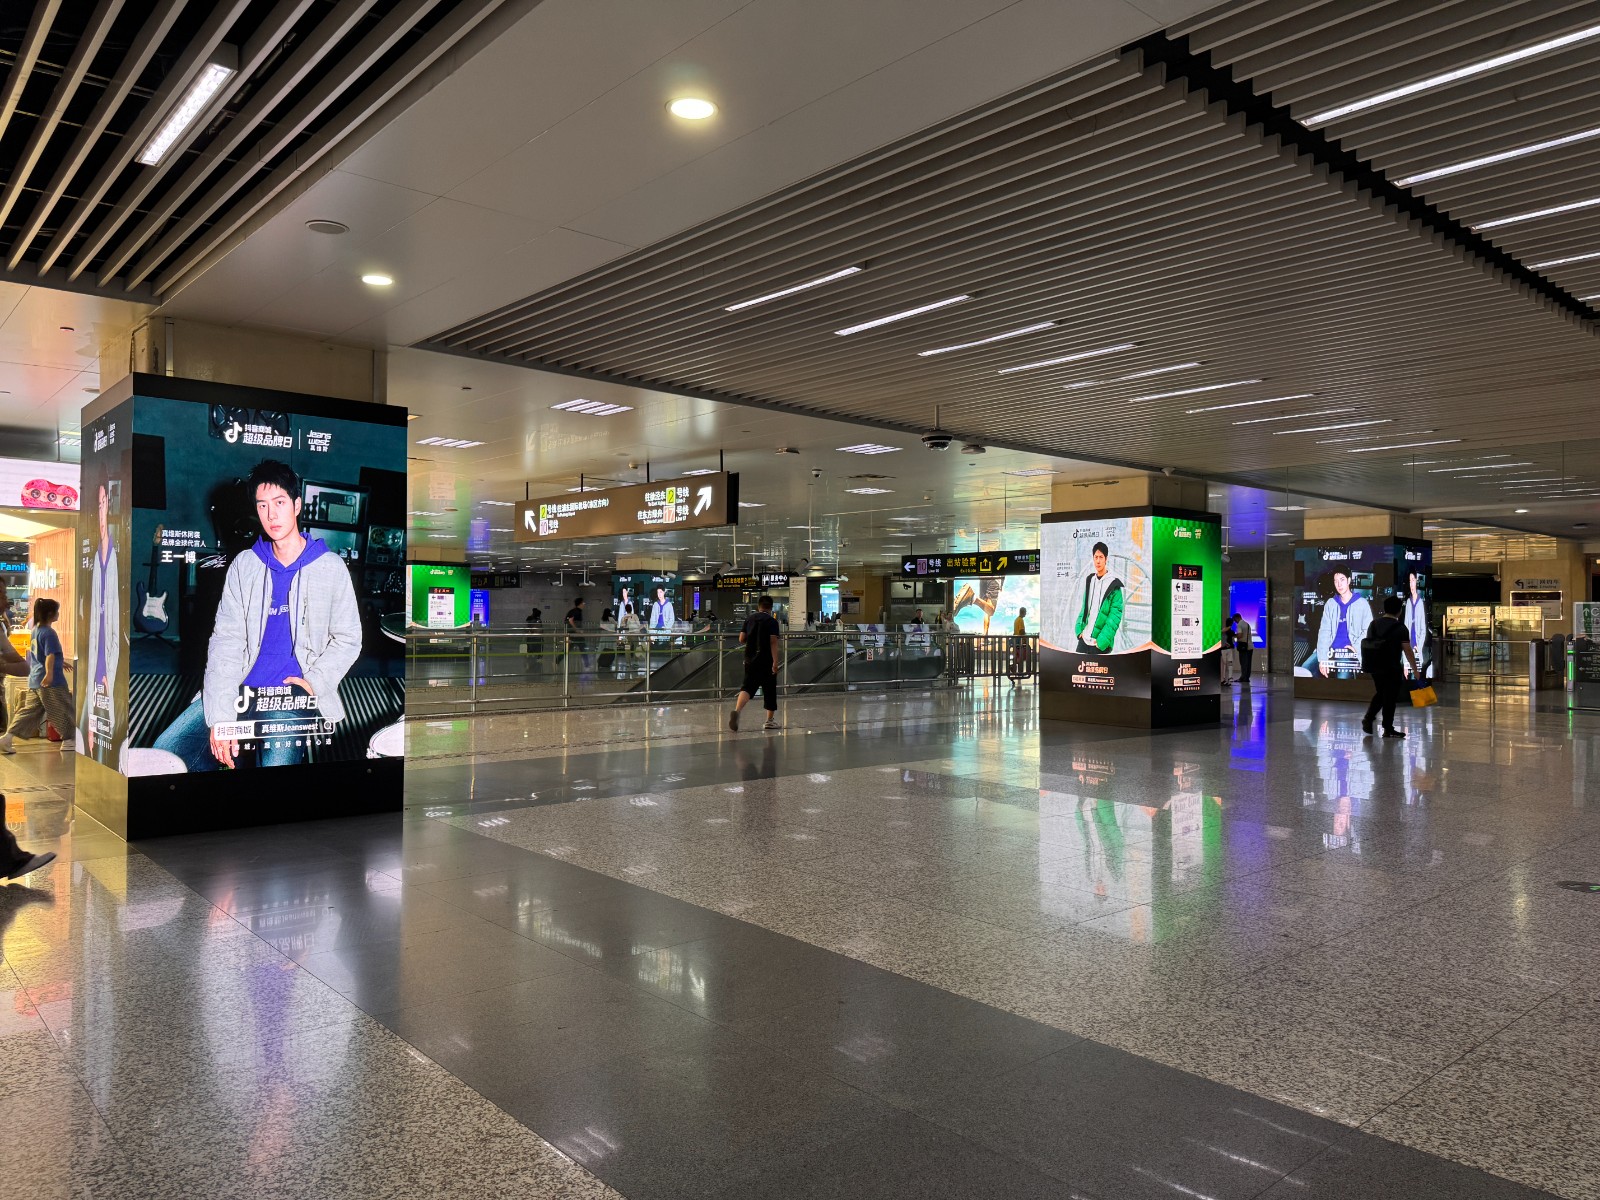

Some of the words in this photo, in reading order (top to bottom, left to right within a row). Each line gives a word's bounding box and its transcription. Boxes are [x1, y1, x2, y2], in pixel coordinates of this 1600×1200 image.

[307, 430, 332, 439] Jeans
[243, 433, 293, 448] 超级品牌日
[677, 487, 689, 498] 号线
[664, 508, 675, 522] 17
[677, 505, 689, 515] 号线
[161, 551, 196, 563] 王一博
[929, 559, 941, 567] 号线
[947, 557, 976, 567] 出站验票
[257, 686, 292, 696] 抖音商城
[255, 695, 318, 711] 超级品牌日
[217, 725, 252, 736] 抖音商城
